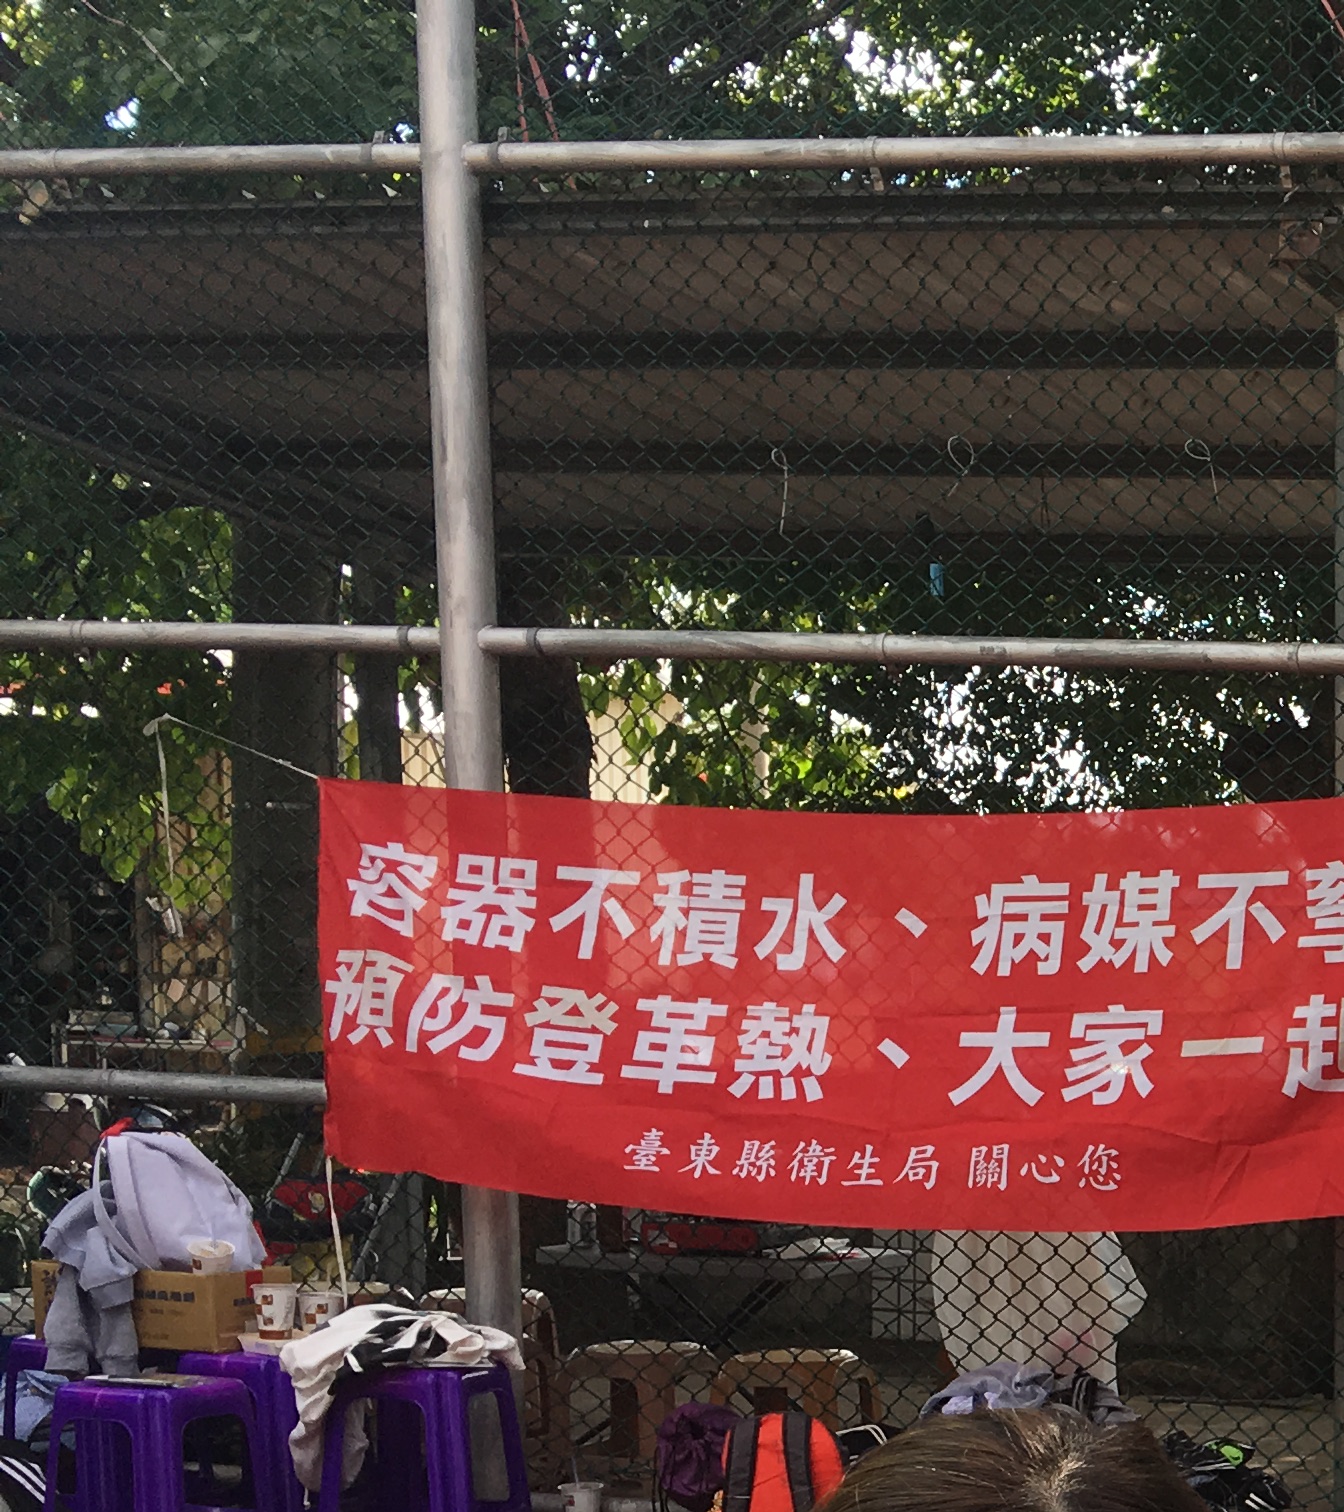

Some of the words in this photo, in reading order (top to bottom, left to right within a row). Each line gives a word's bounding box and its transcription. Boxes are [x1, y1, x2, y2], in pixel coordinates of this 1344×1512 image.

[623, 1127, 941, 1190] 臺東縣衛生局
[968, 1141, 1122, 1192] 關心您
